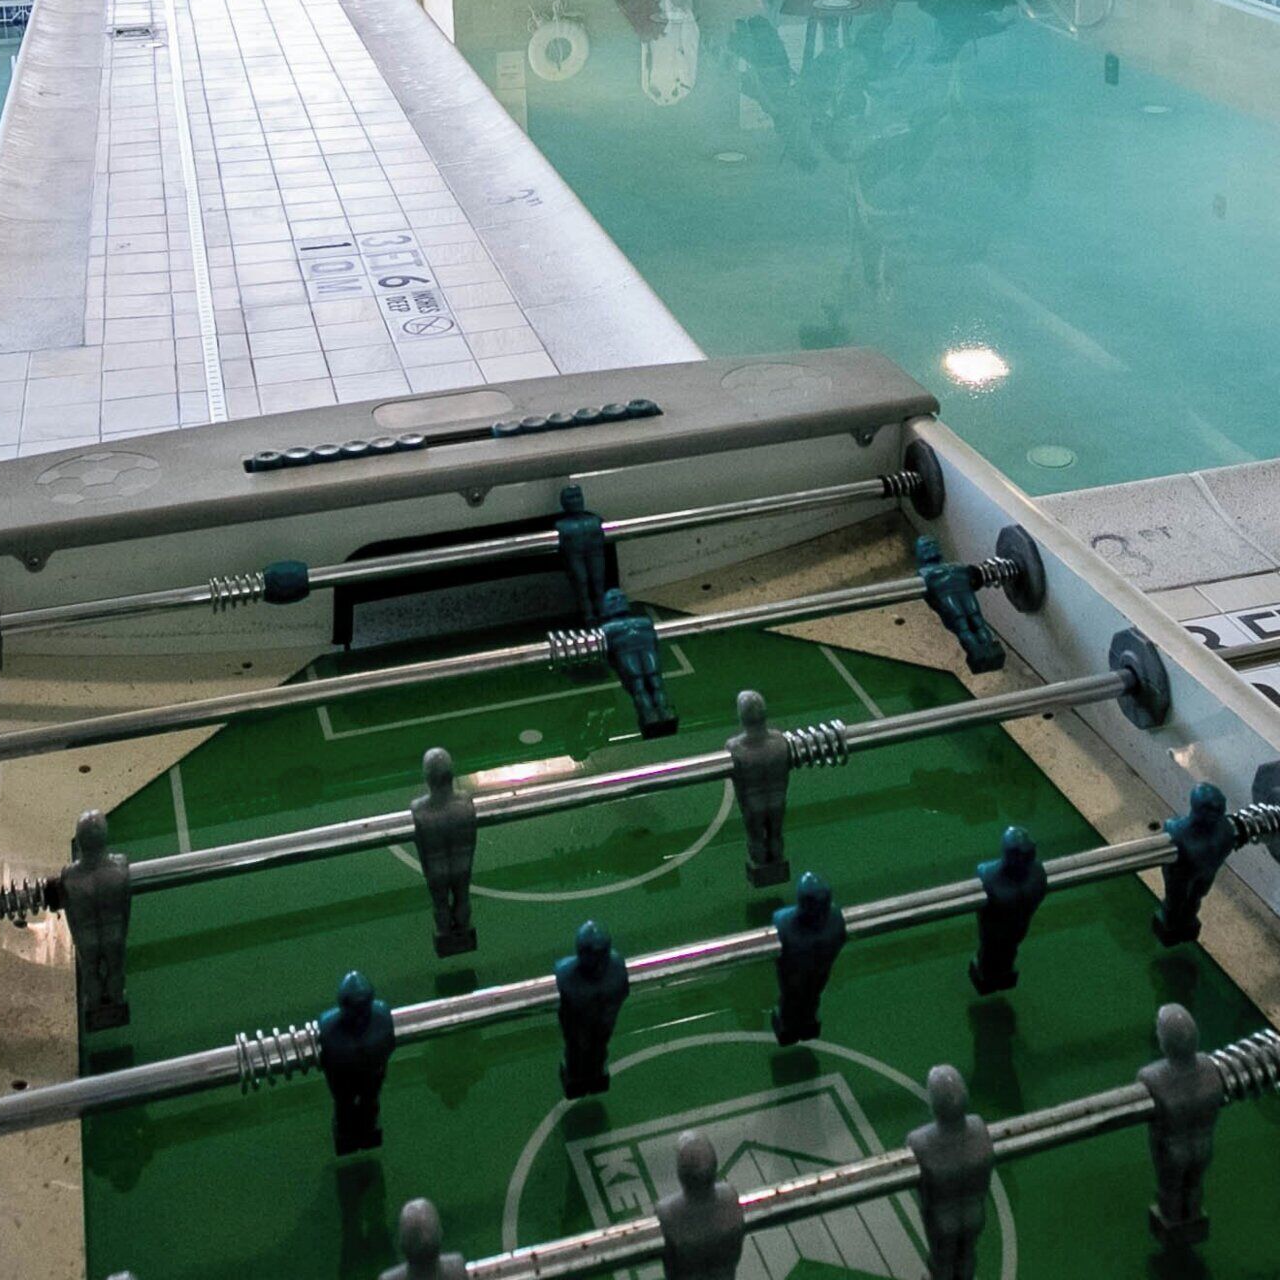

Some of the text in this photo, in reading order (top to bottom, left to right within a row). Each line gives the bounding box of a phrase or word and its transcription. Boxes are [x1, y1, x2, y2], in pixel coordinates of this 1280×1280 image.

[378, 275, 431, 288] 6
[385, 295, 411, 313] DEEP
[411, 290, 441, 314] INCHES
